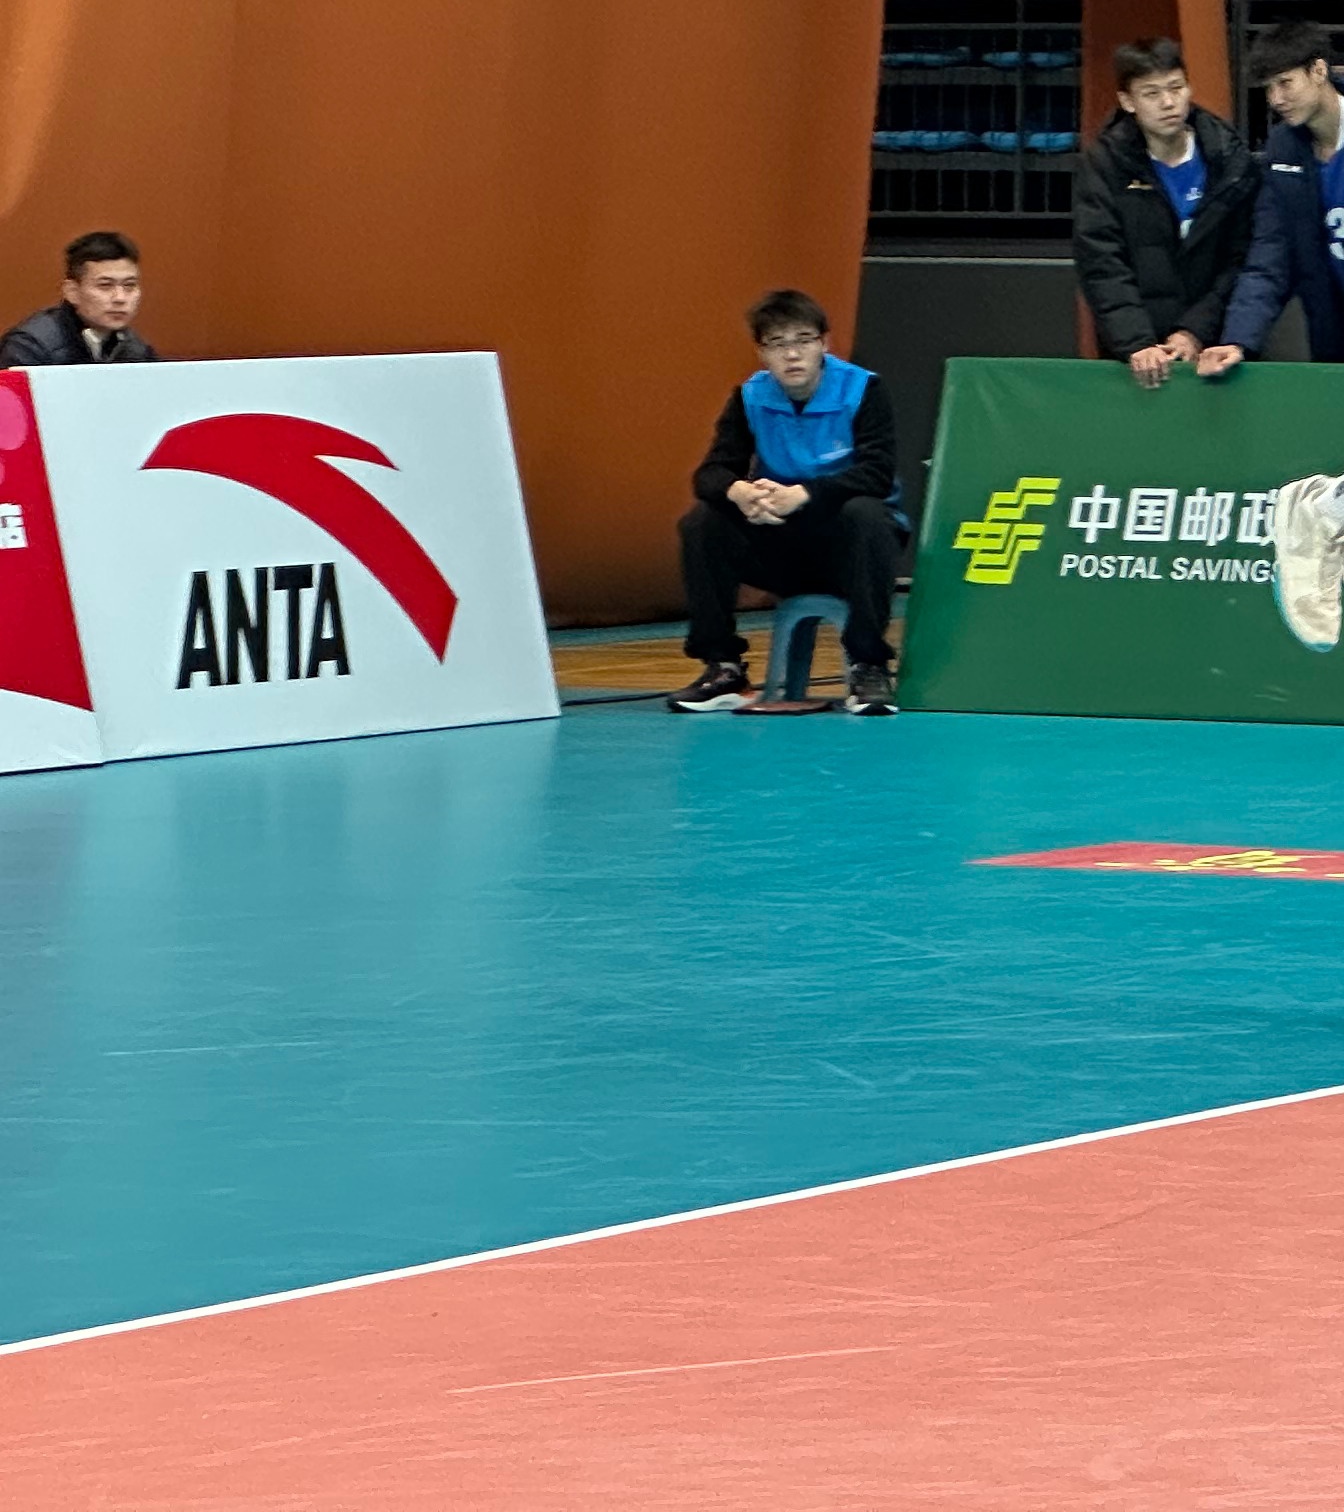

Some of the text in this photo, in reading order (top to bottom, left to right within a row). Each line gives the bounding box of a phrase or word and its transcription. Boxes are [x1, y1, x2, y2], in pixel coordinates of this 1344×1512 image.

[1059, 553, 1163, 580] POSTAL
[1170, 557, 1277, 583] SAVING
[175, 562, 351, 690] ANTA
